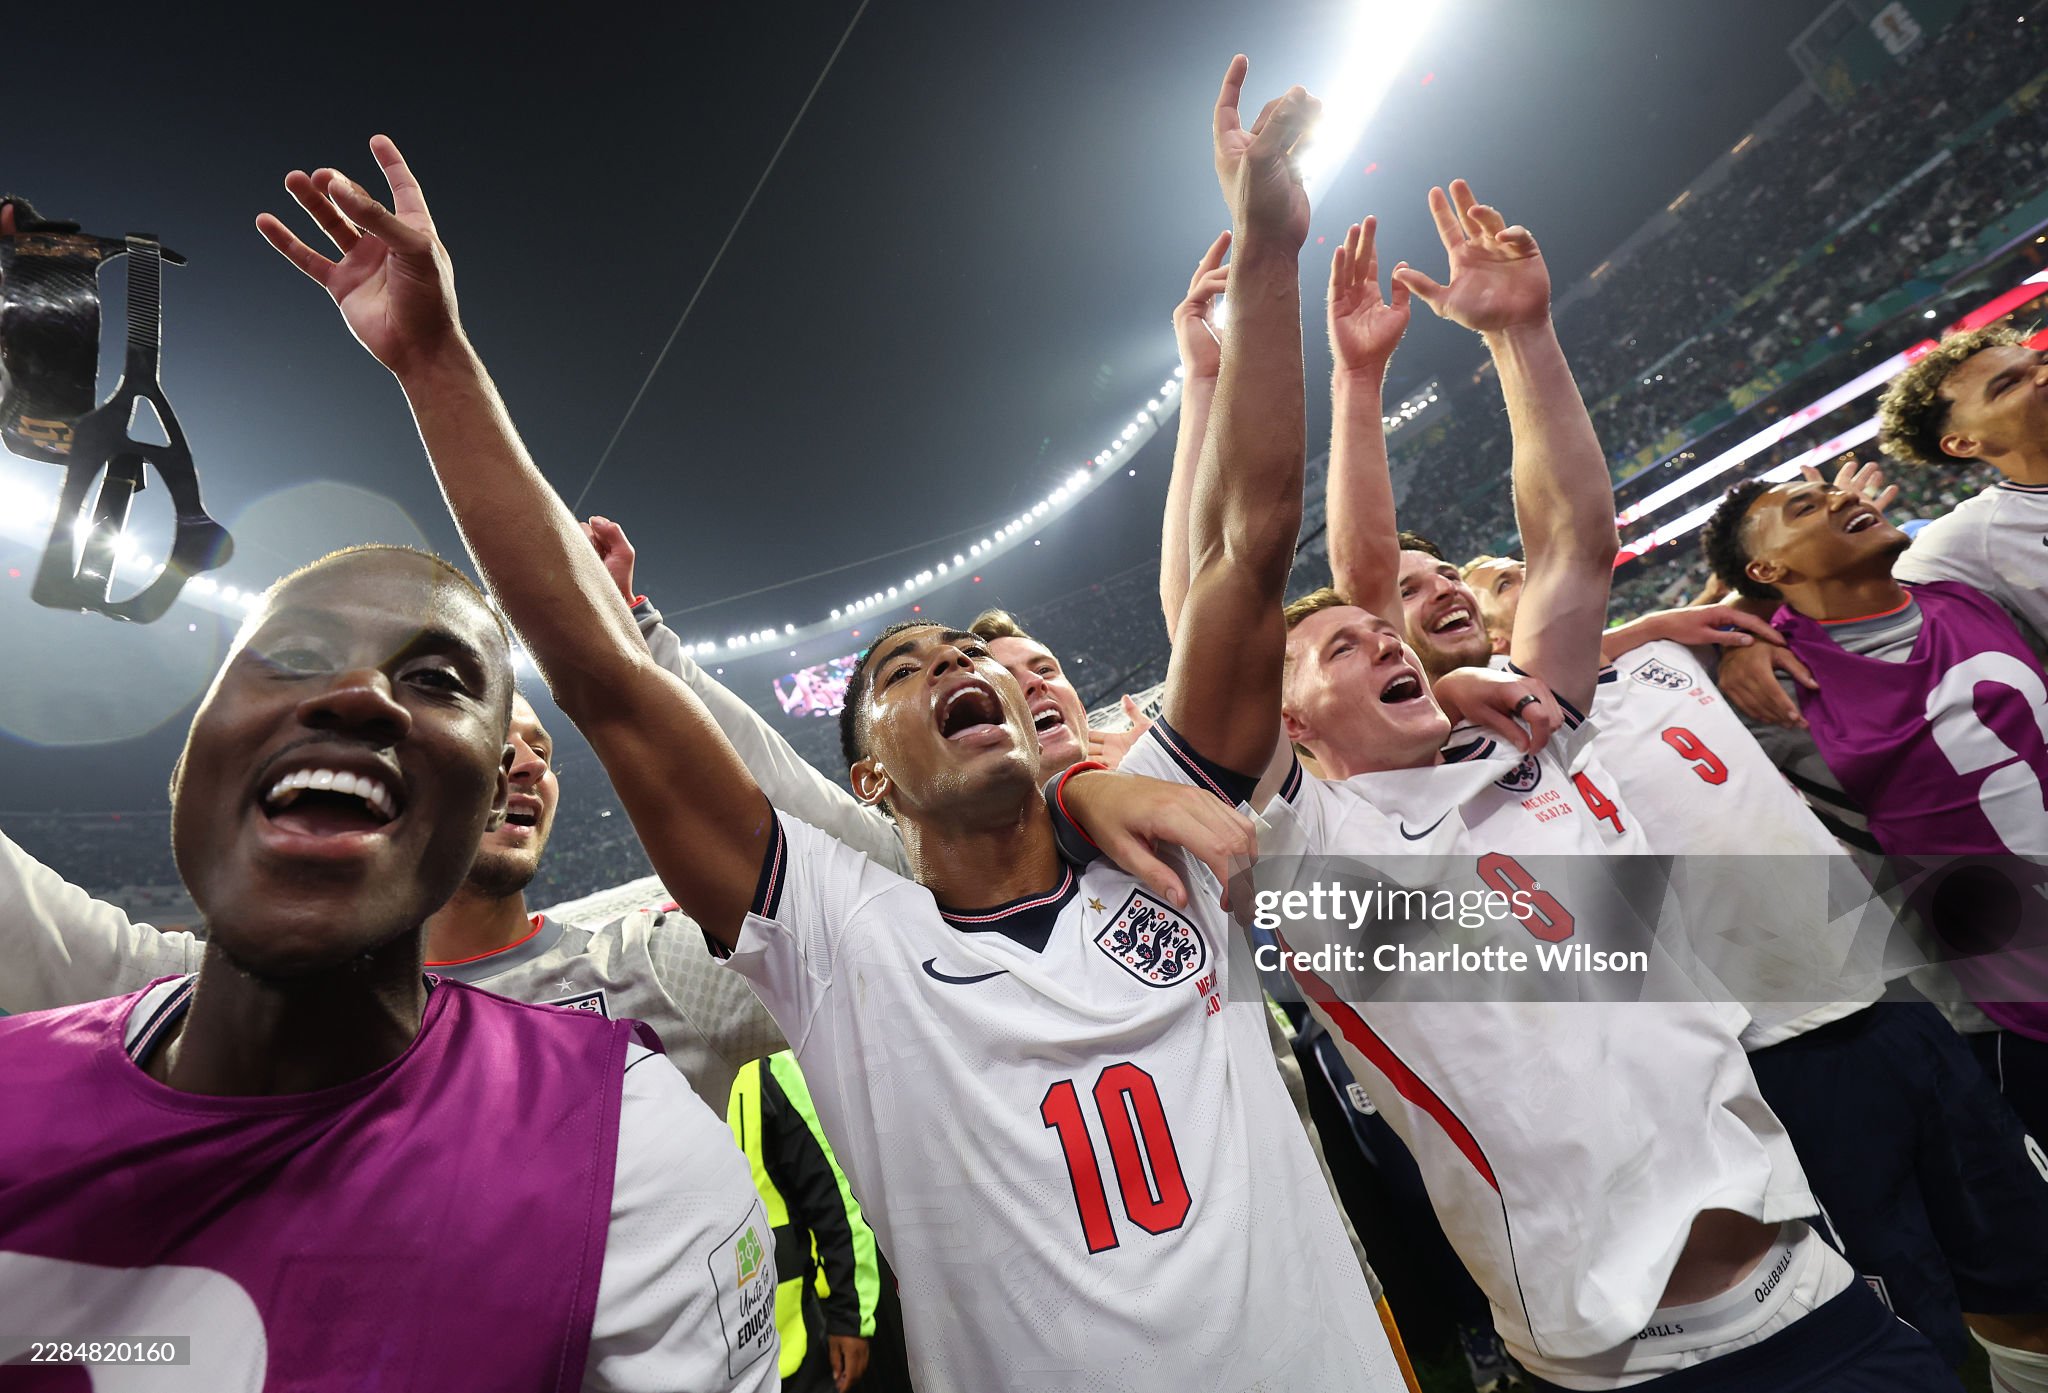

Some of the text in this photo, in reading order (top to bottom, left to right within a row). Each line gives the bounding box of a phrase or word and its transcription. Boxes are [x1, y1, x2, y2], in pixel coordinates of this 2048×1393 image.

[1661, 726, 1729, 786] 9
[1521, 789, 1561, 812] MEXICO
[1571, 770, 1627, 834] 4
[1476, 851, 1575, 944] 8
[1039, 1061, 1193, 1255] 10
